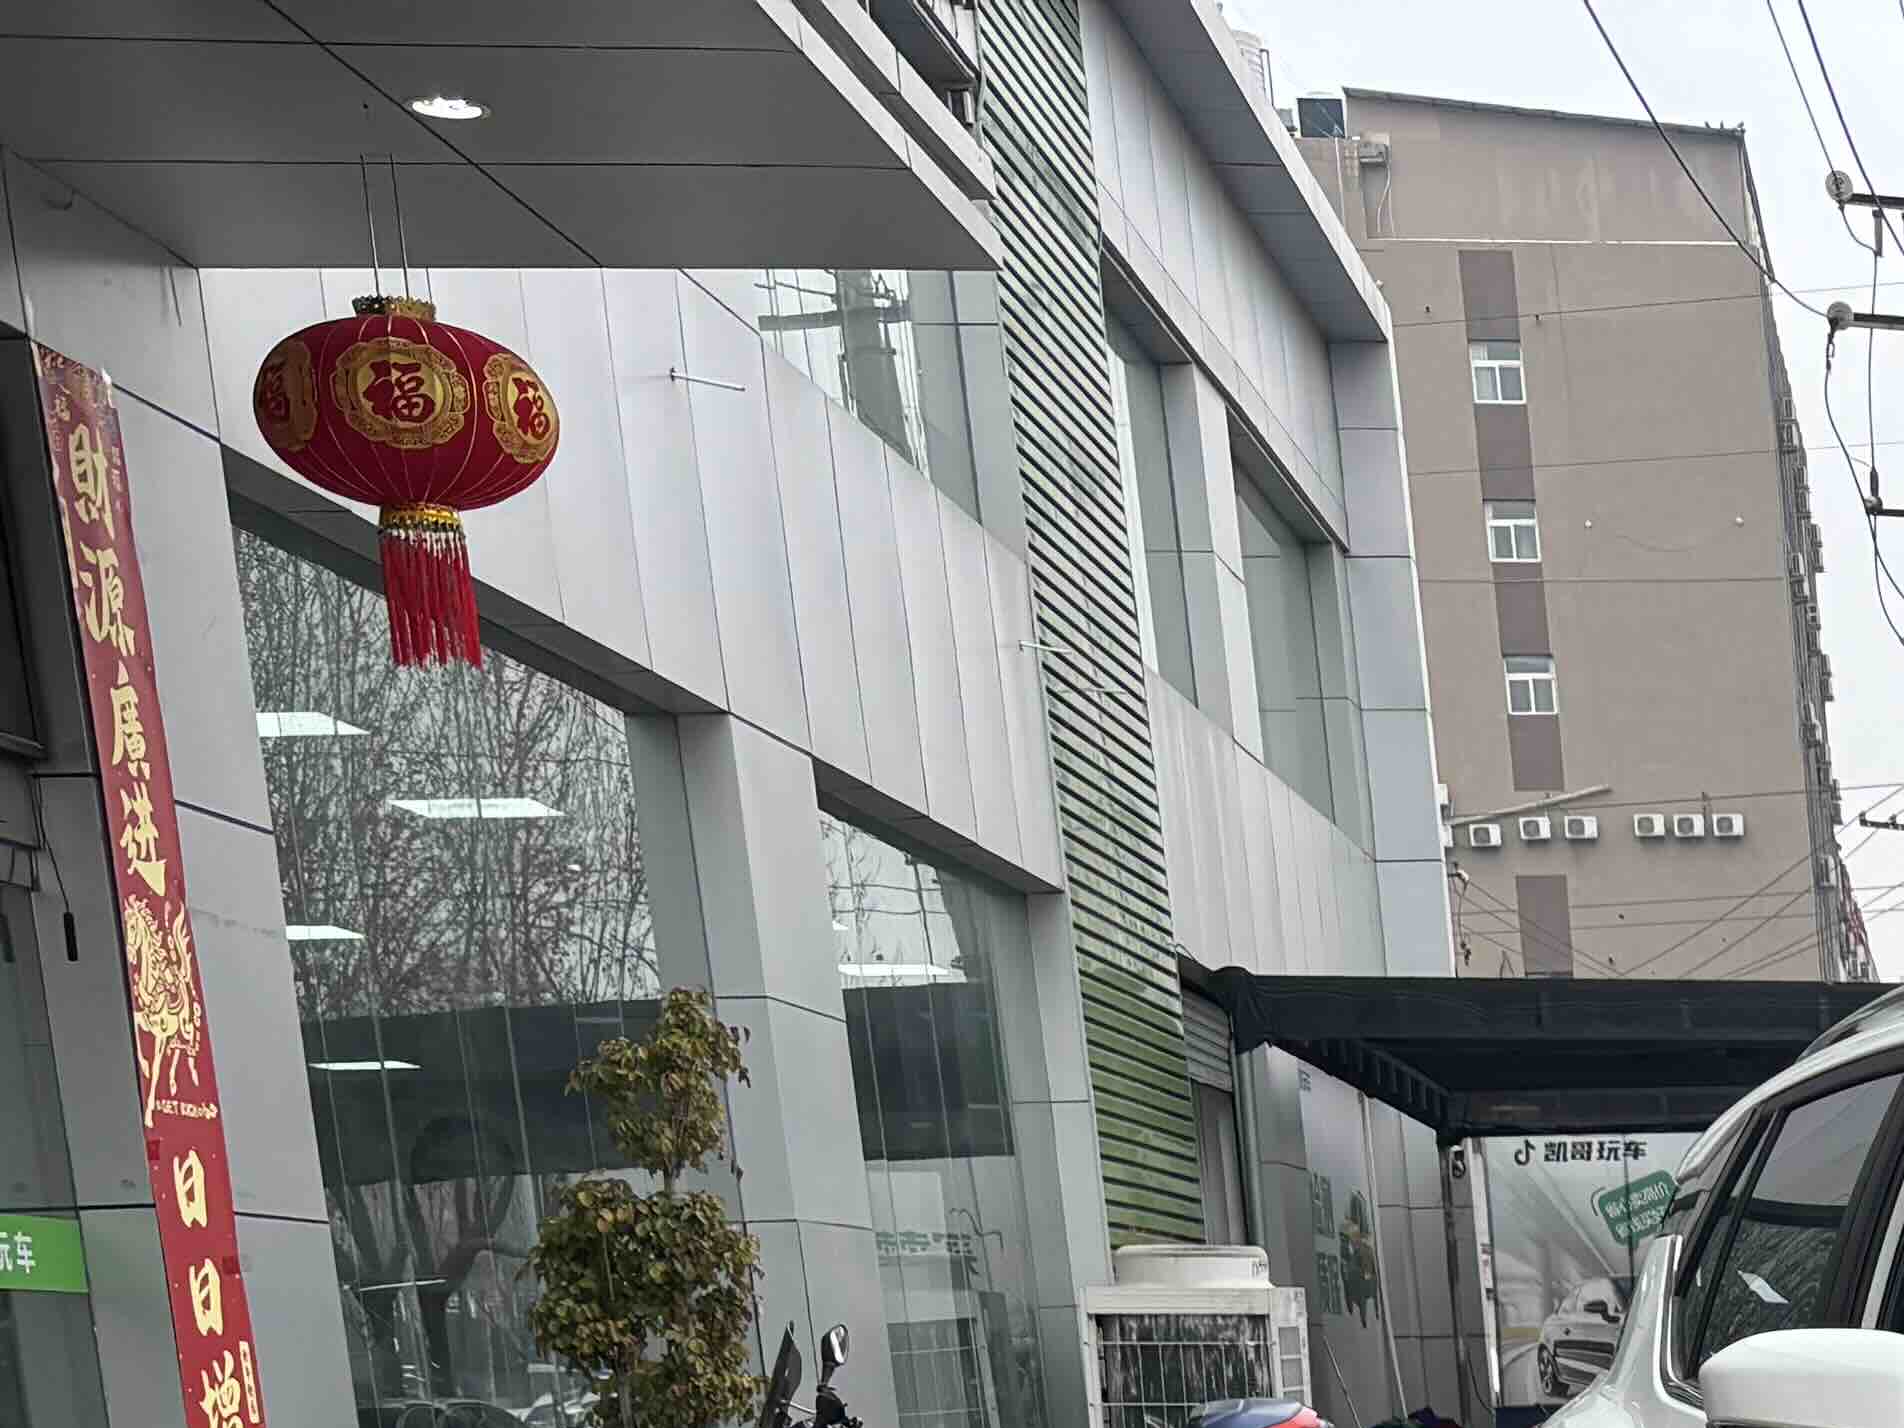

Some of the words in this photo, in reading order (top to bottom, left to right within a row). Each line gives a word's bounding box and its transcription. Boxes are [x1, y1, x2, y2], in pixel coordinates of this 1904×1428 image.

[363, 359, 436, 423] 福
[512, 377, 550, 440] 福
[1544, 1140, 1647, 1163] 凯哥玩车
